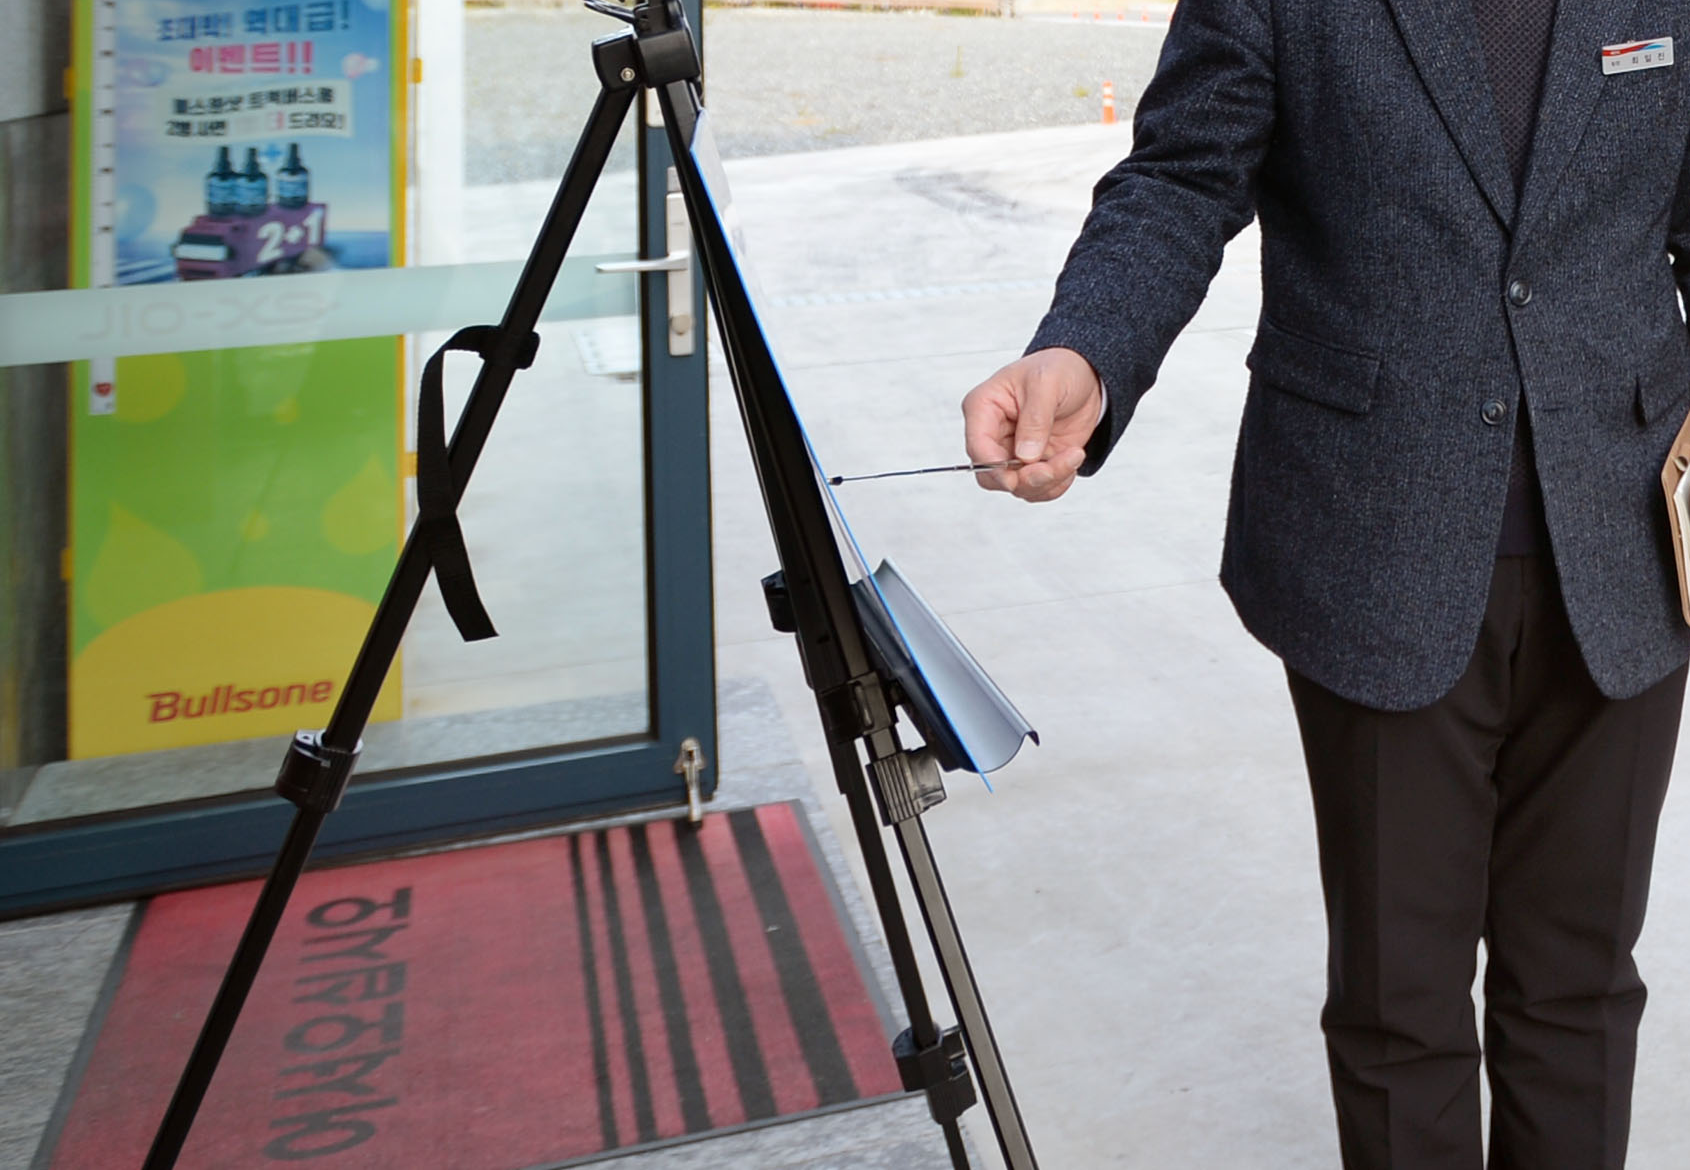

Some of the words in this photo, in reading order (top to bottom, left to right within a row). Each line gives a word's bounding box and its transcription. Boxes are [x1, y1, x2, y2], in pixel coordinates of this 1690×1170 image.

[189, 41, 313, 74] 이벤트!!
[257, 207, 325, 263] 2+1
[146, 677, 334, 724] Bullsone
